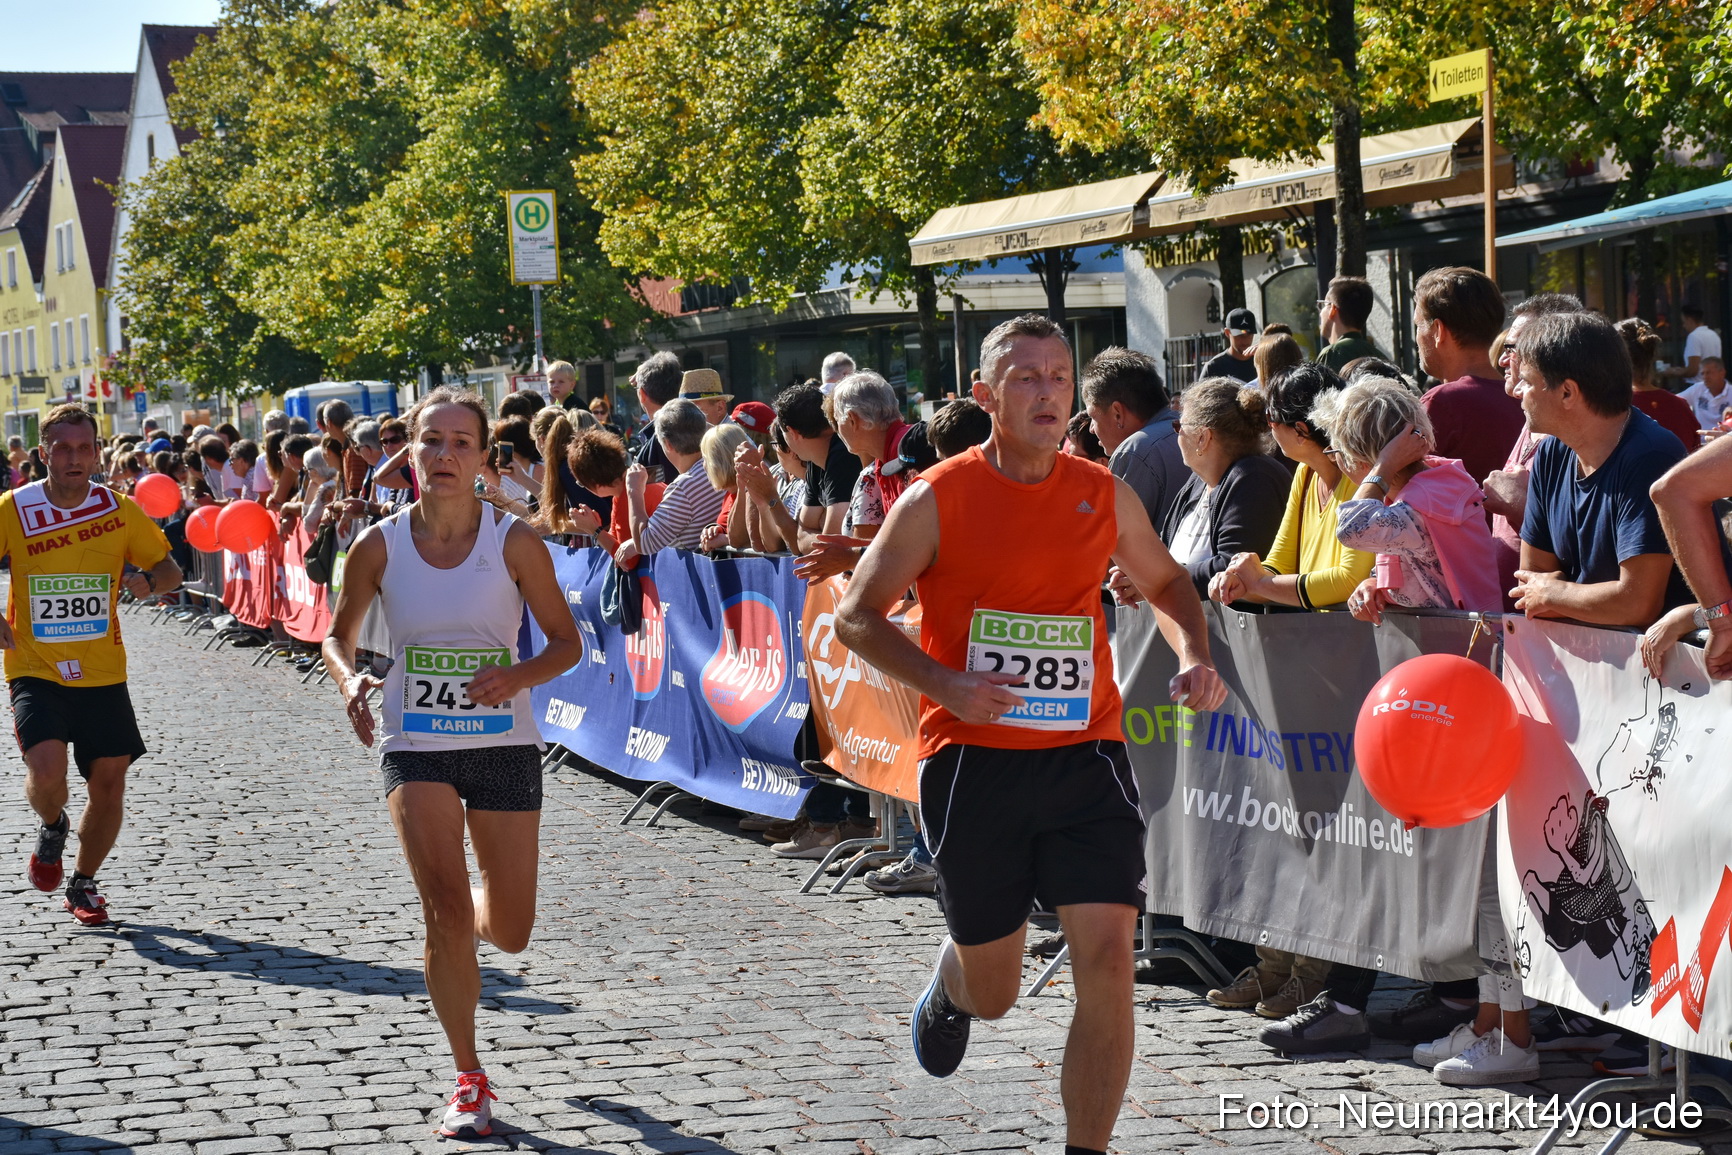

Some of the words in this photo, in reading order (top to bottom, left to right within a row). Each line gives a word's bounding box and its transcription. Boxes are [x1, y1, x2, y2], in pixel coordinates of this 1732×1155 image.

[1441, 66, 1483, 87] Toiletten
[26, 534, 73, 557] MAX
[78, 516, 126, 542] BÖGL
[35, 576, 104, 593] BOCK
[568, 590, 583, 604] STORE
[40, 597, 101, 619] 2380
[44, 624, 97, 635] MICHAEL
[980, 615, 1084, 646] BOCK
[413, 650, 503, 673] BOCK
[708, 626, 782, 701] Hervis
[984, 651, 1081, 691] 2283
[416, 680, 501, 710] 243
[1372, 688, 1455, 719] RÖDL
[1006, 701, 1069, 717] RGEN
[1410, 713, 1453, 727] energie
[431, 719, 484, 732] KARIN
[843, 727, 901, 765] Agentur
[1206, 711, 1353, 774] INDUSTRY
[741, 757, 762, 790] GET
